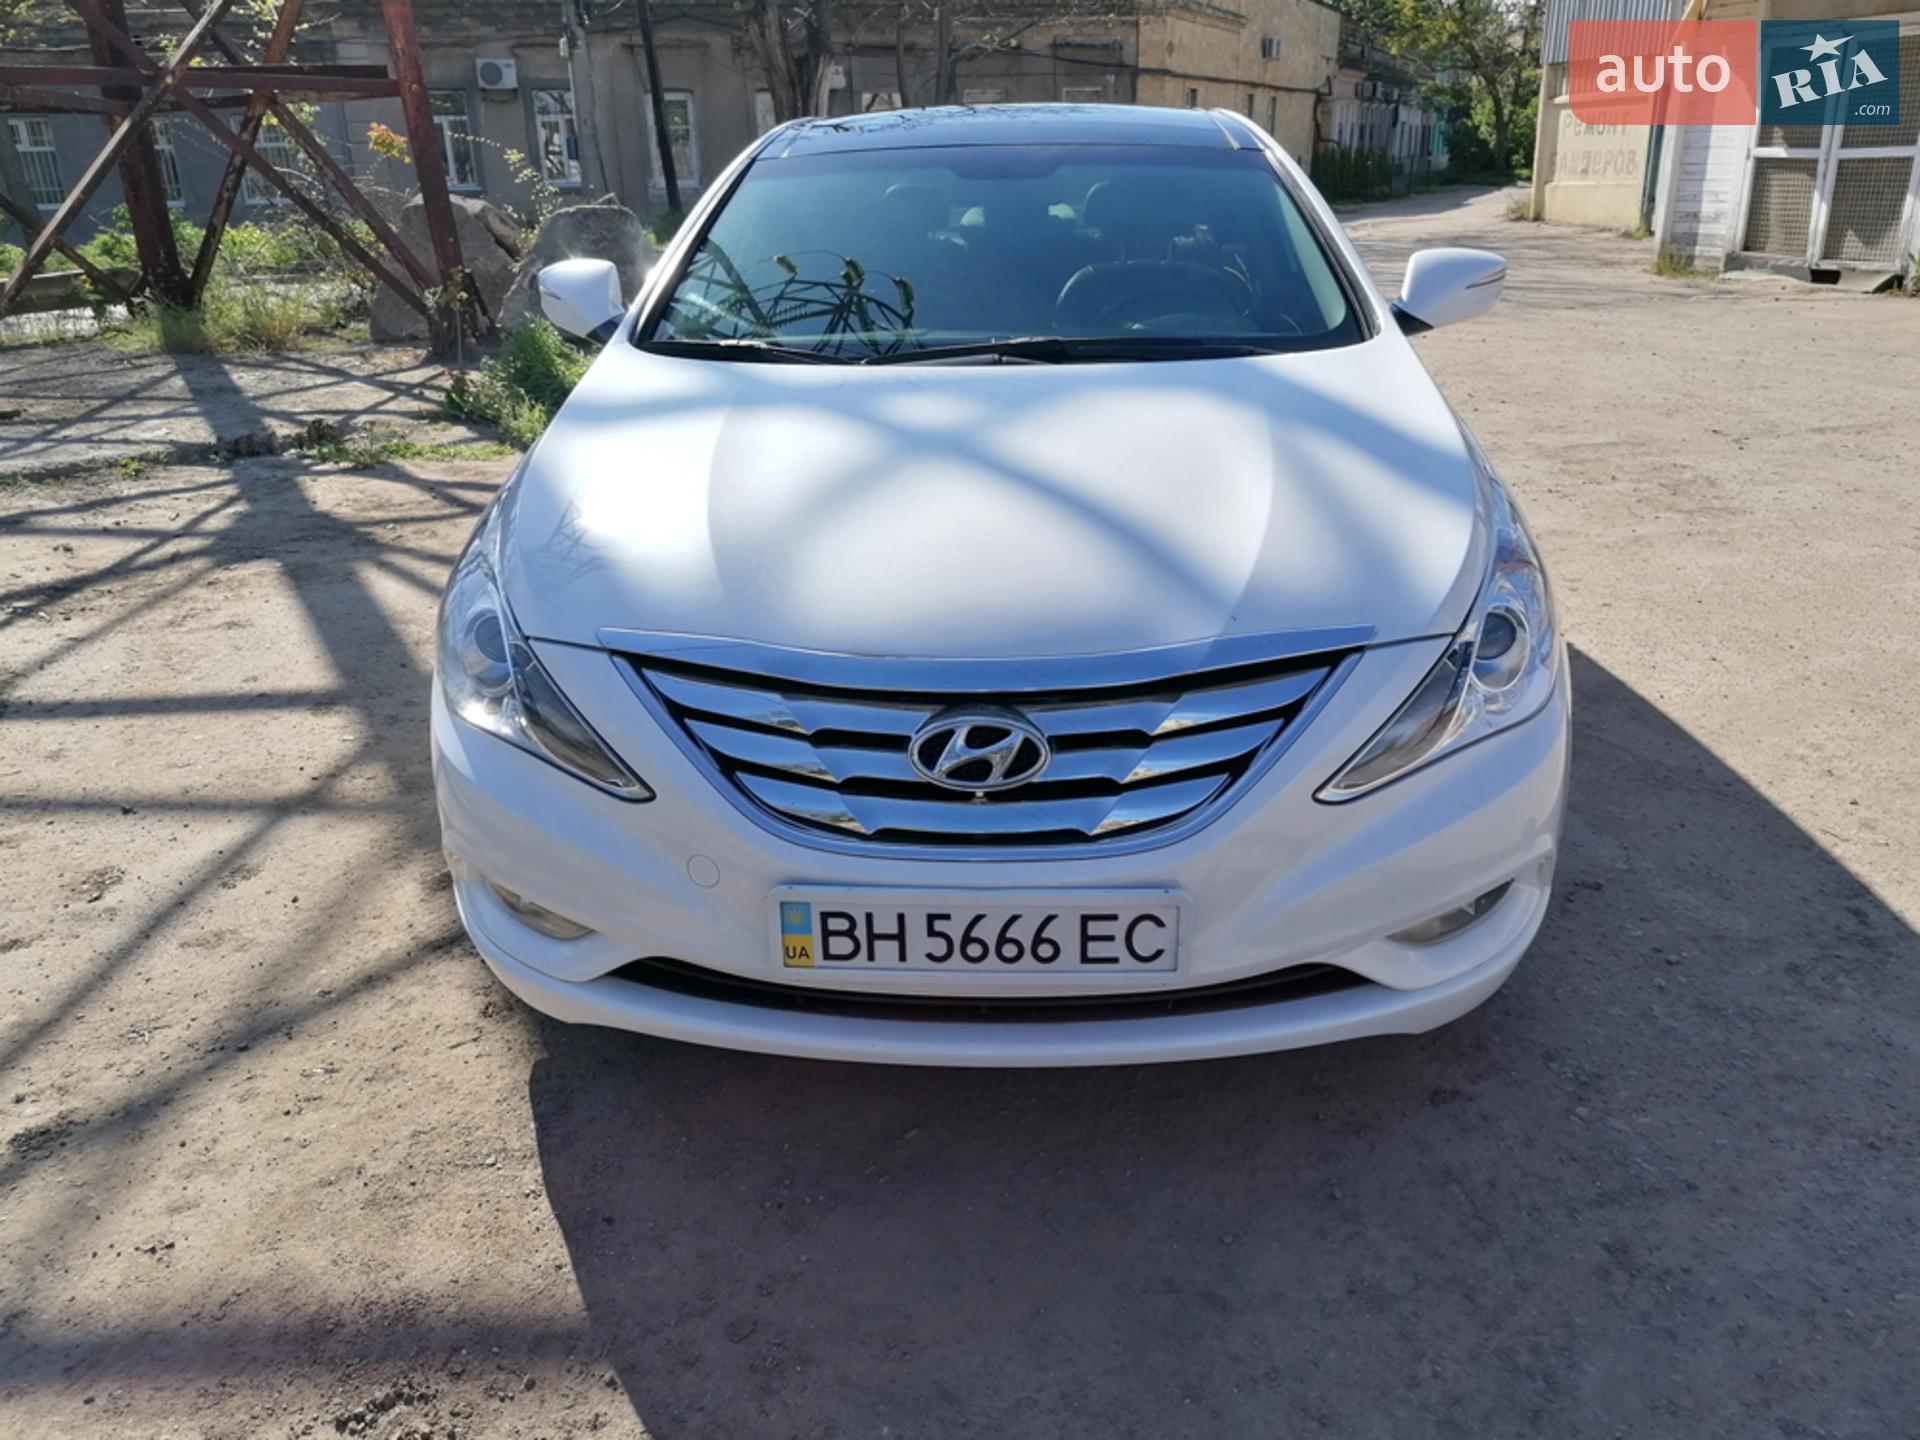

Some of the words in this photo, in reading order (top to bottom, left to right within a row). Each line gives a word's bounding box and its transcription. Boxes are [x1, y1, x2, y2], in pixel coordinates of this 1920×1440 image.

[784, 945, 811, 961] UA
[819, 911, 907, 963] BH
[924, 913, 1062, 964] 5666
[1079, 913, 1167, 964] EC
